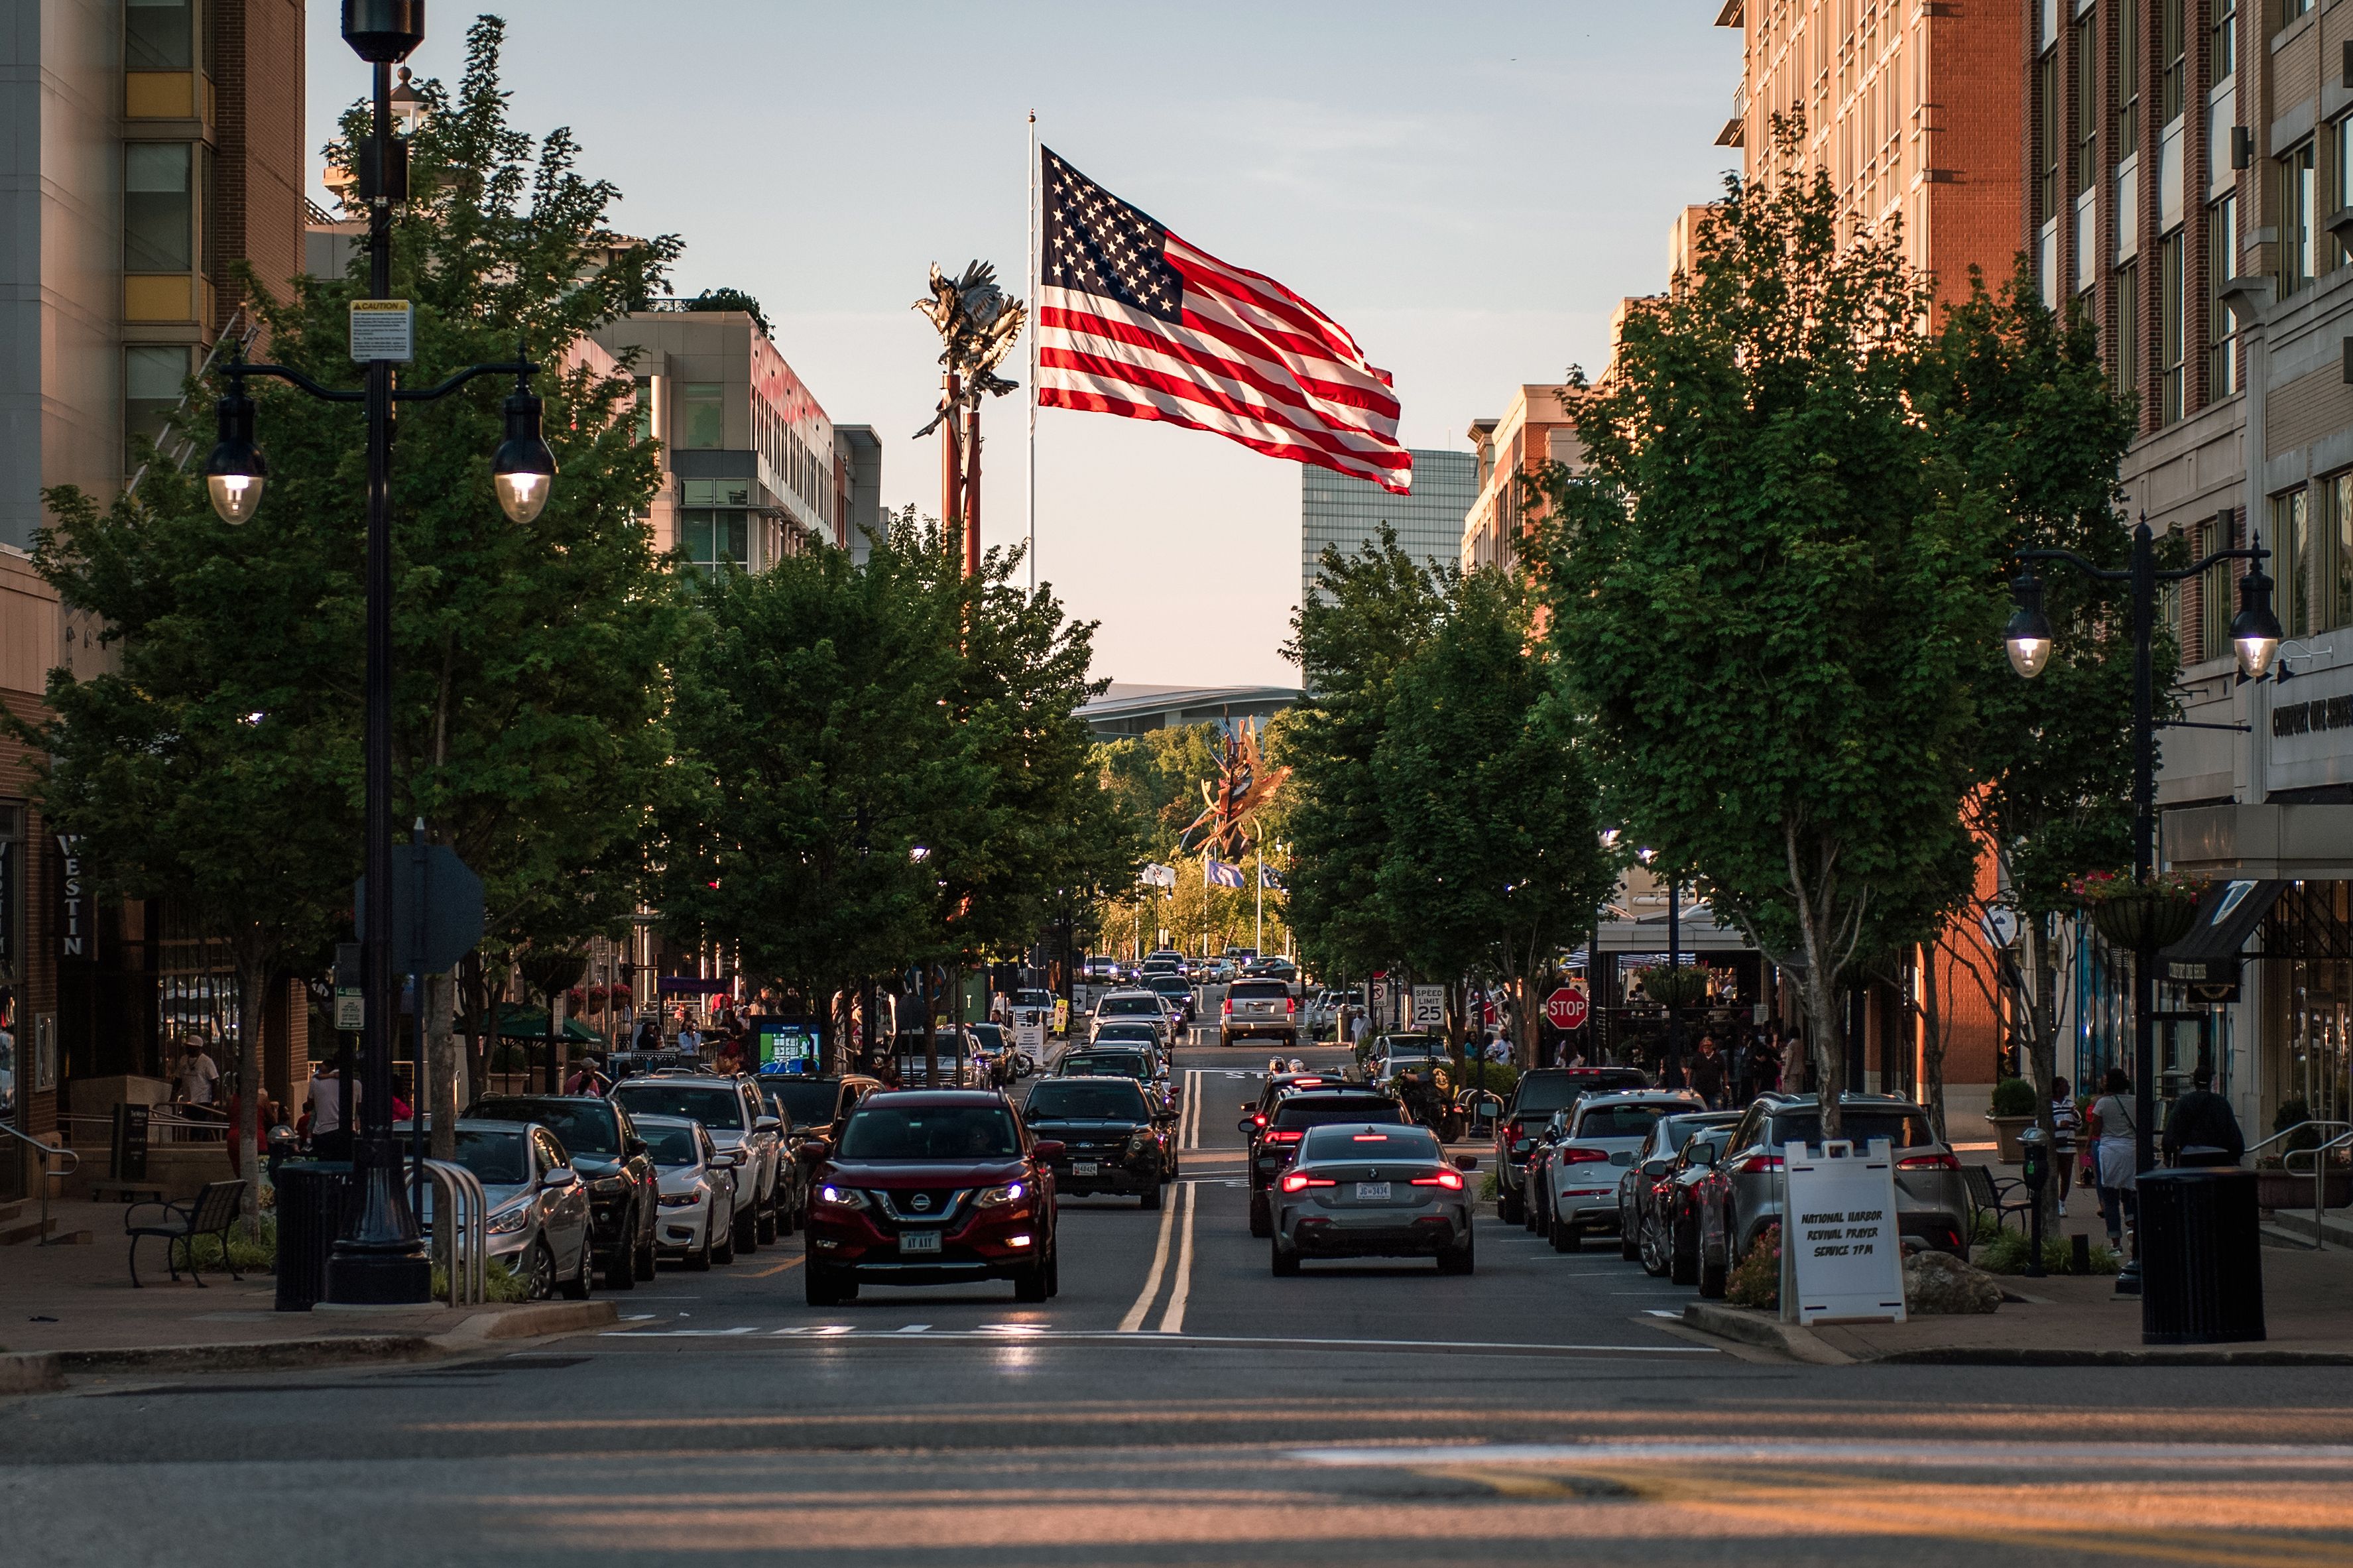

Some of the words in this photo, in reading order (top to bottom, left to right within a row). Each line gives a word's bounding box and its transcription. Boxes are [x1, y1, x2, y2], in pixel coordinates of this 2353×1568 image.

[1418, 1006, 1441, 1020] 25
[1549, 1000, 1585, 1016] STOP
[1801, 1212, 1844, 1225] NATIONAL
[1848, 1211, 1882, 1223] HARBOR
[1807, 1229, 1842, 1241] REVIVAL
[1846, 1227, 1878, 1238] PRAYER
[1814, 1244, 1849, 1257] SERVICE
[1853, 1244, 1873, 1256] 7PM
